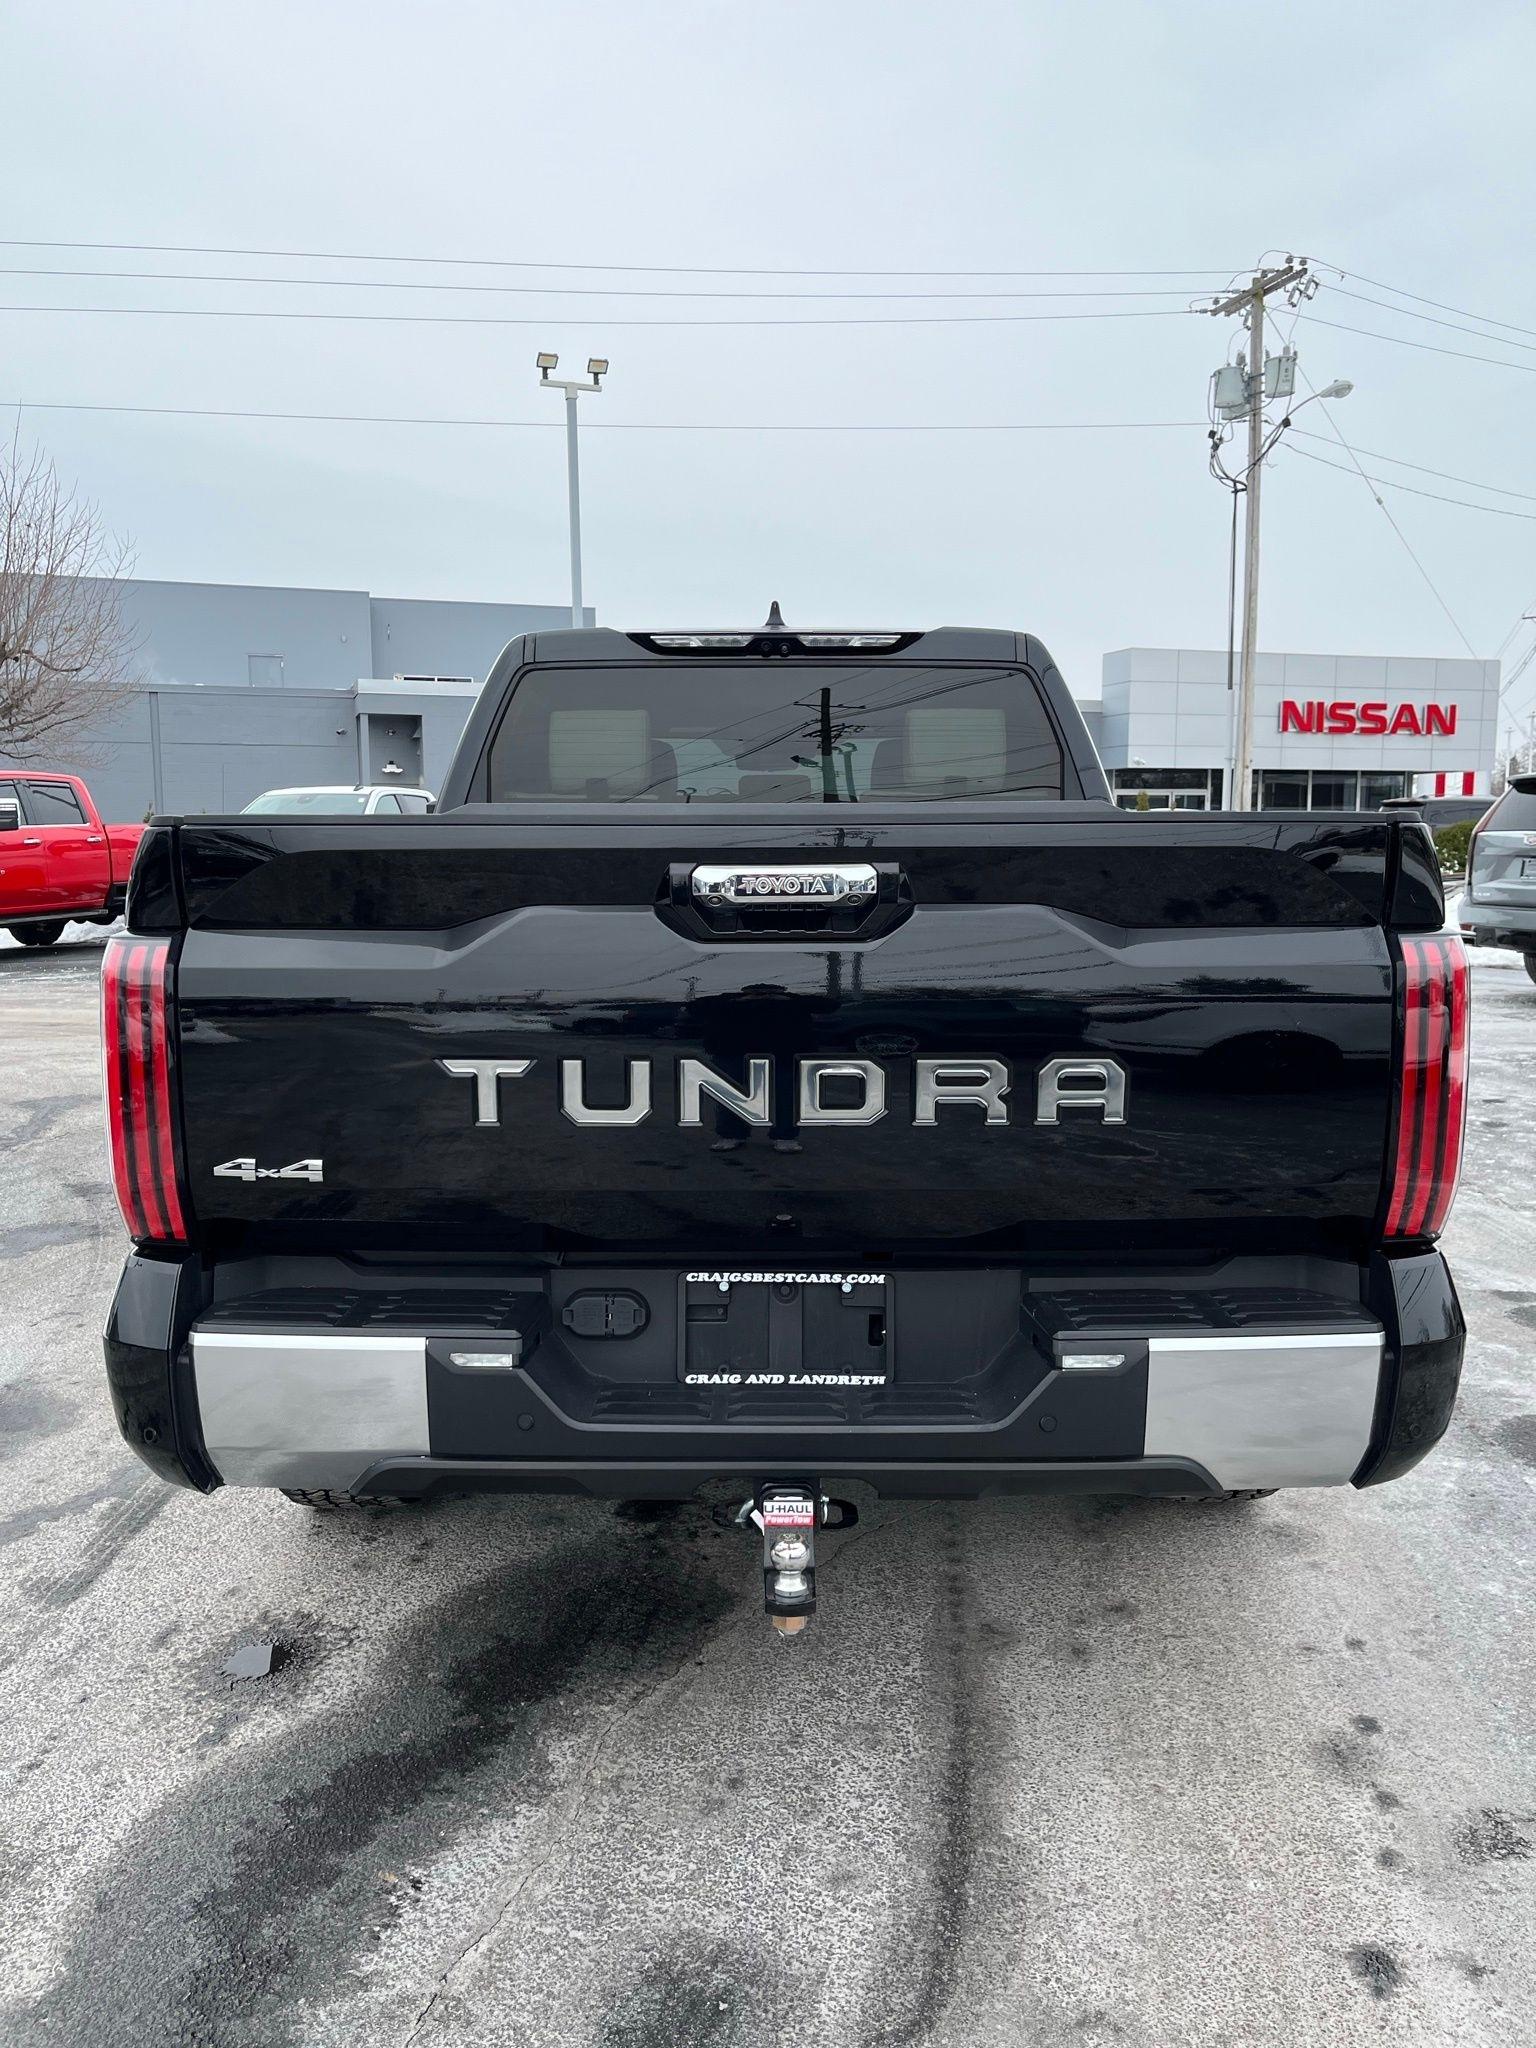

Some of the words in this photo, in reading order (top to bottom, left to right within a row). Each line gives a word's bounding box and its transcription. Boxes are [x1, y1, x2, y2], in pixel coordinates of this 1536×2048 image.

[1281, 700, 1457, 735] NISSAN
[742, 875, 828, 894] TOYOTA
[434, 1057, 1128, 1127] TUNDRA
[213, 1158, 324, 1182] 4x4
[686, 1272, 886, 1284] CRAIGSBESTCARS.COM
[685, 1374, 742, 1384] CRAIG
[745, 1374, 785, 1384] AND
[788, 1374, 886, 1385] LANDRETH
[764, 1505, 812, 1513] U-HAUL
